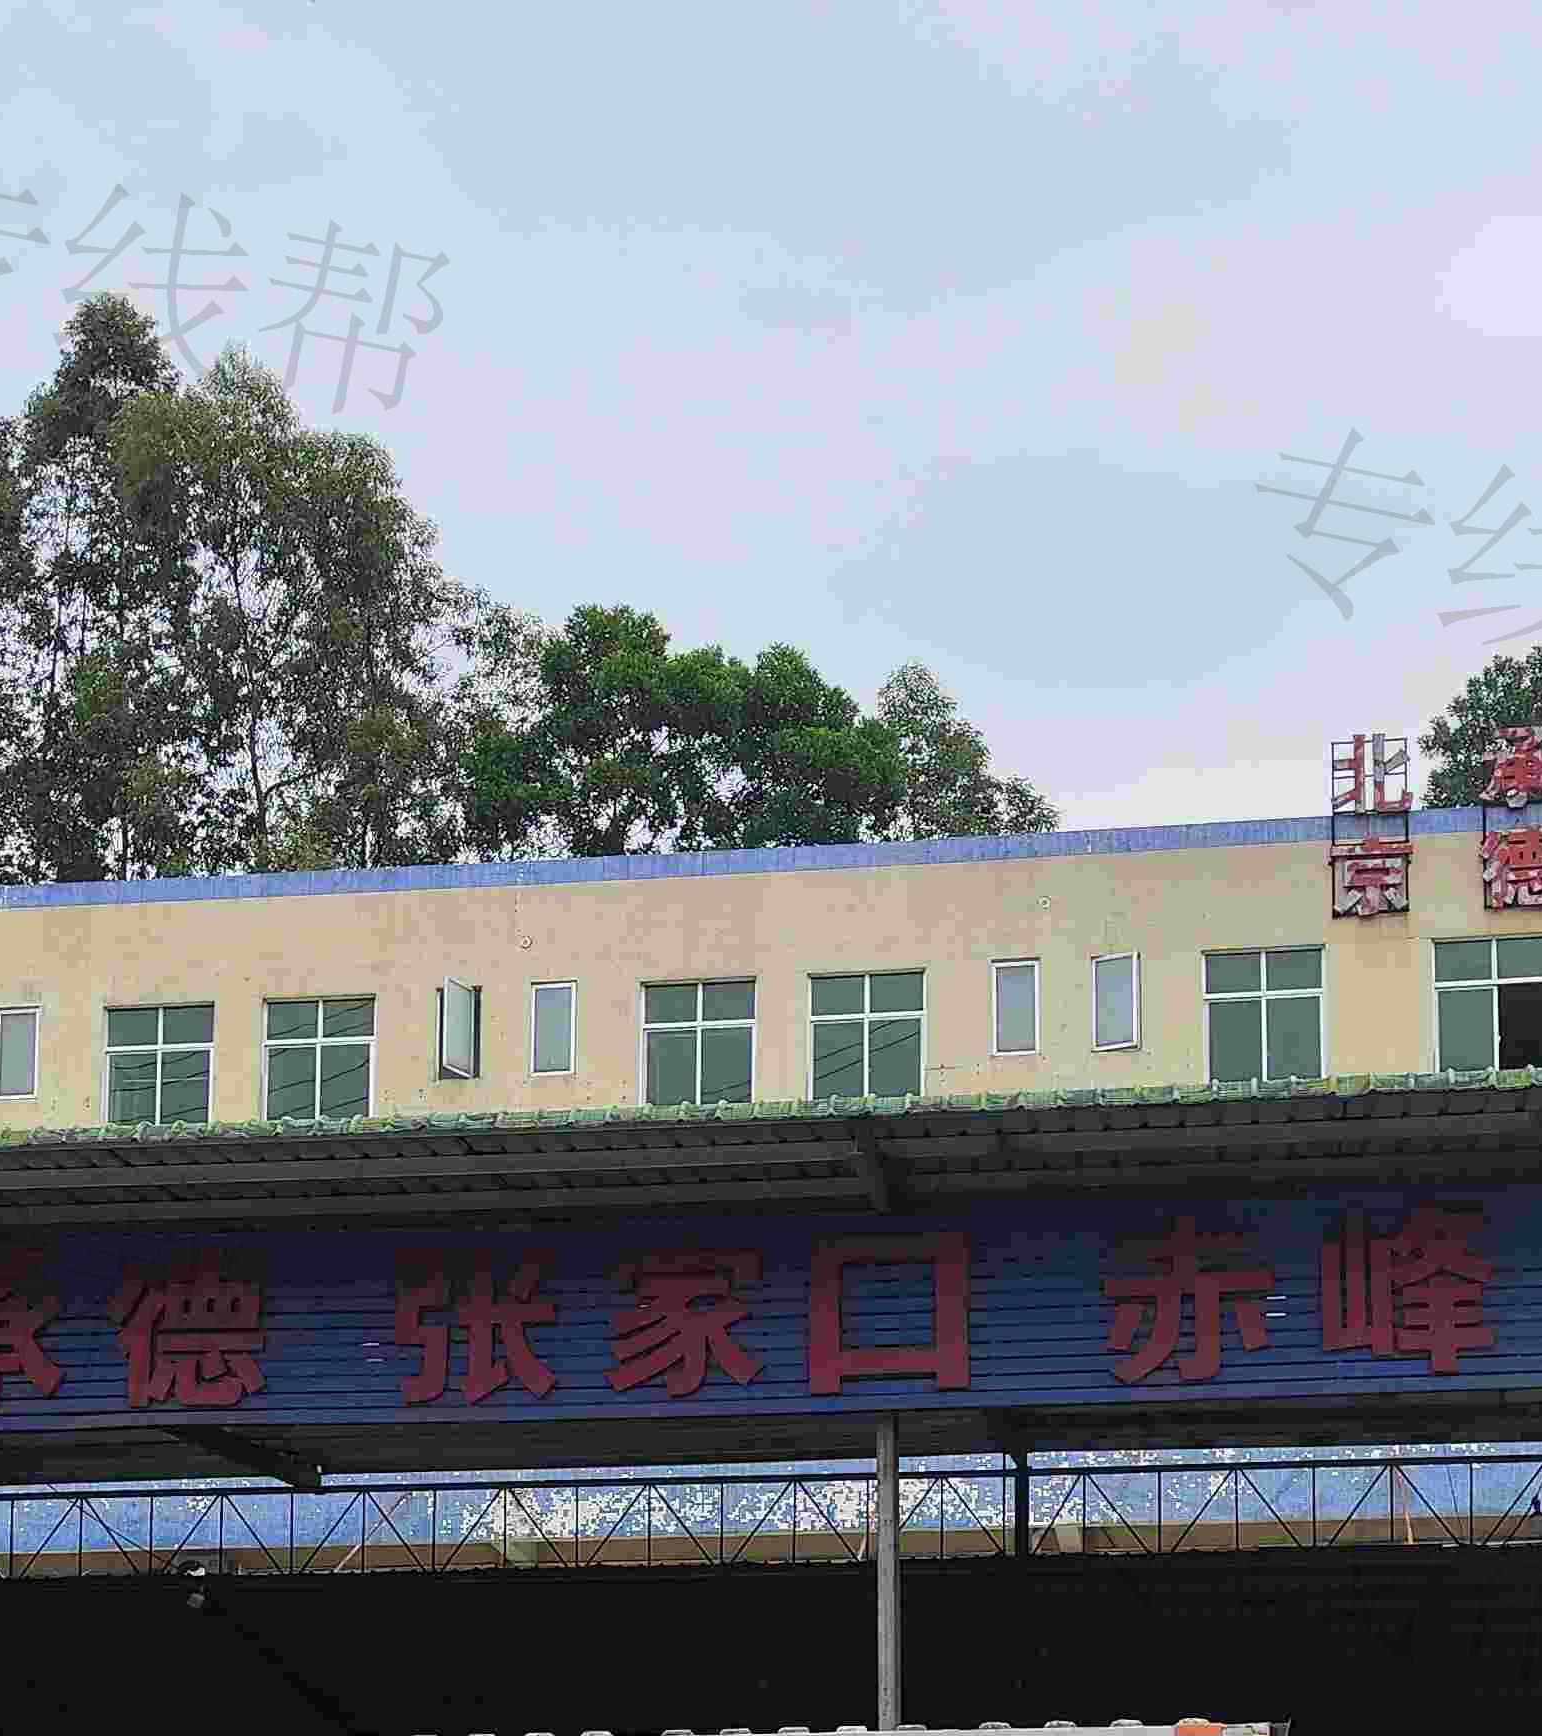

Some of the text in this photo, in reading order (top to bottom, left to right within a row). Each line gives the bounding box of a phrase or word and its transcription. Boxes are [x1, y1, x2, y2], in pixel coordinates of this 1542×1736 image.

[1330, 733, 1415, 918] 北京
[391, 1228, 976, 1408] 张家口
[1102, 1206, 1499, 1384] 赤峰
